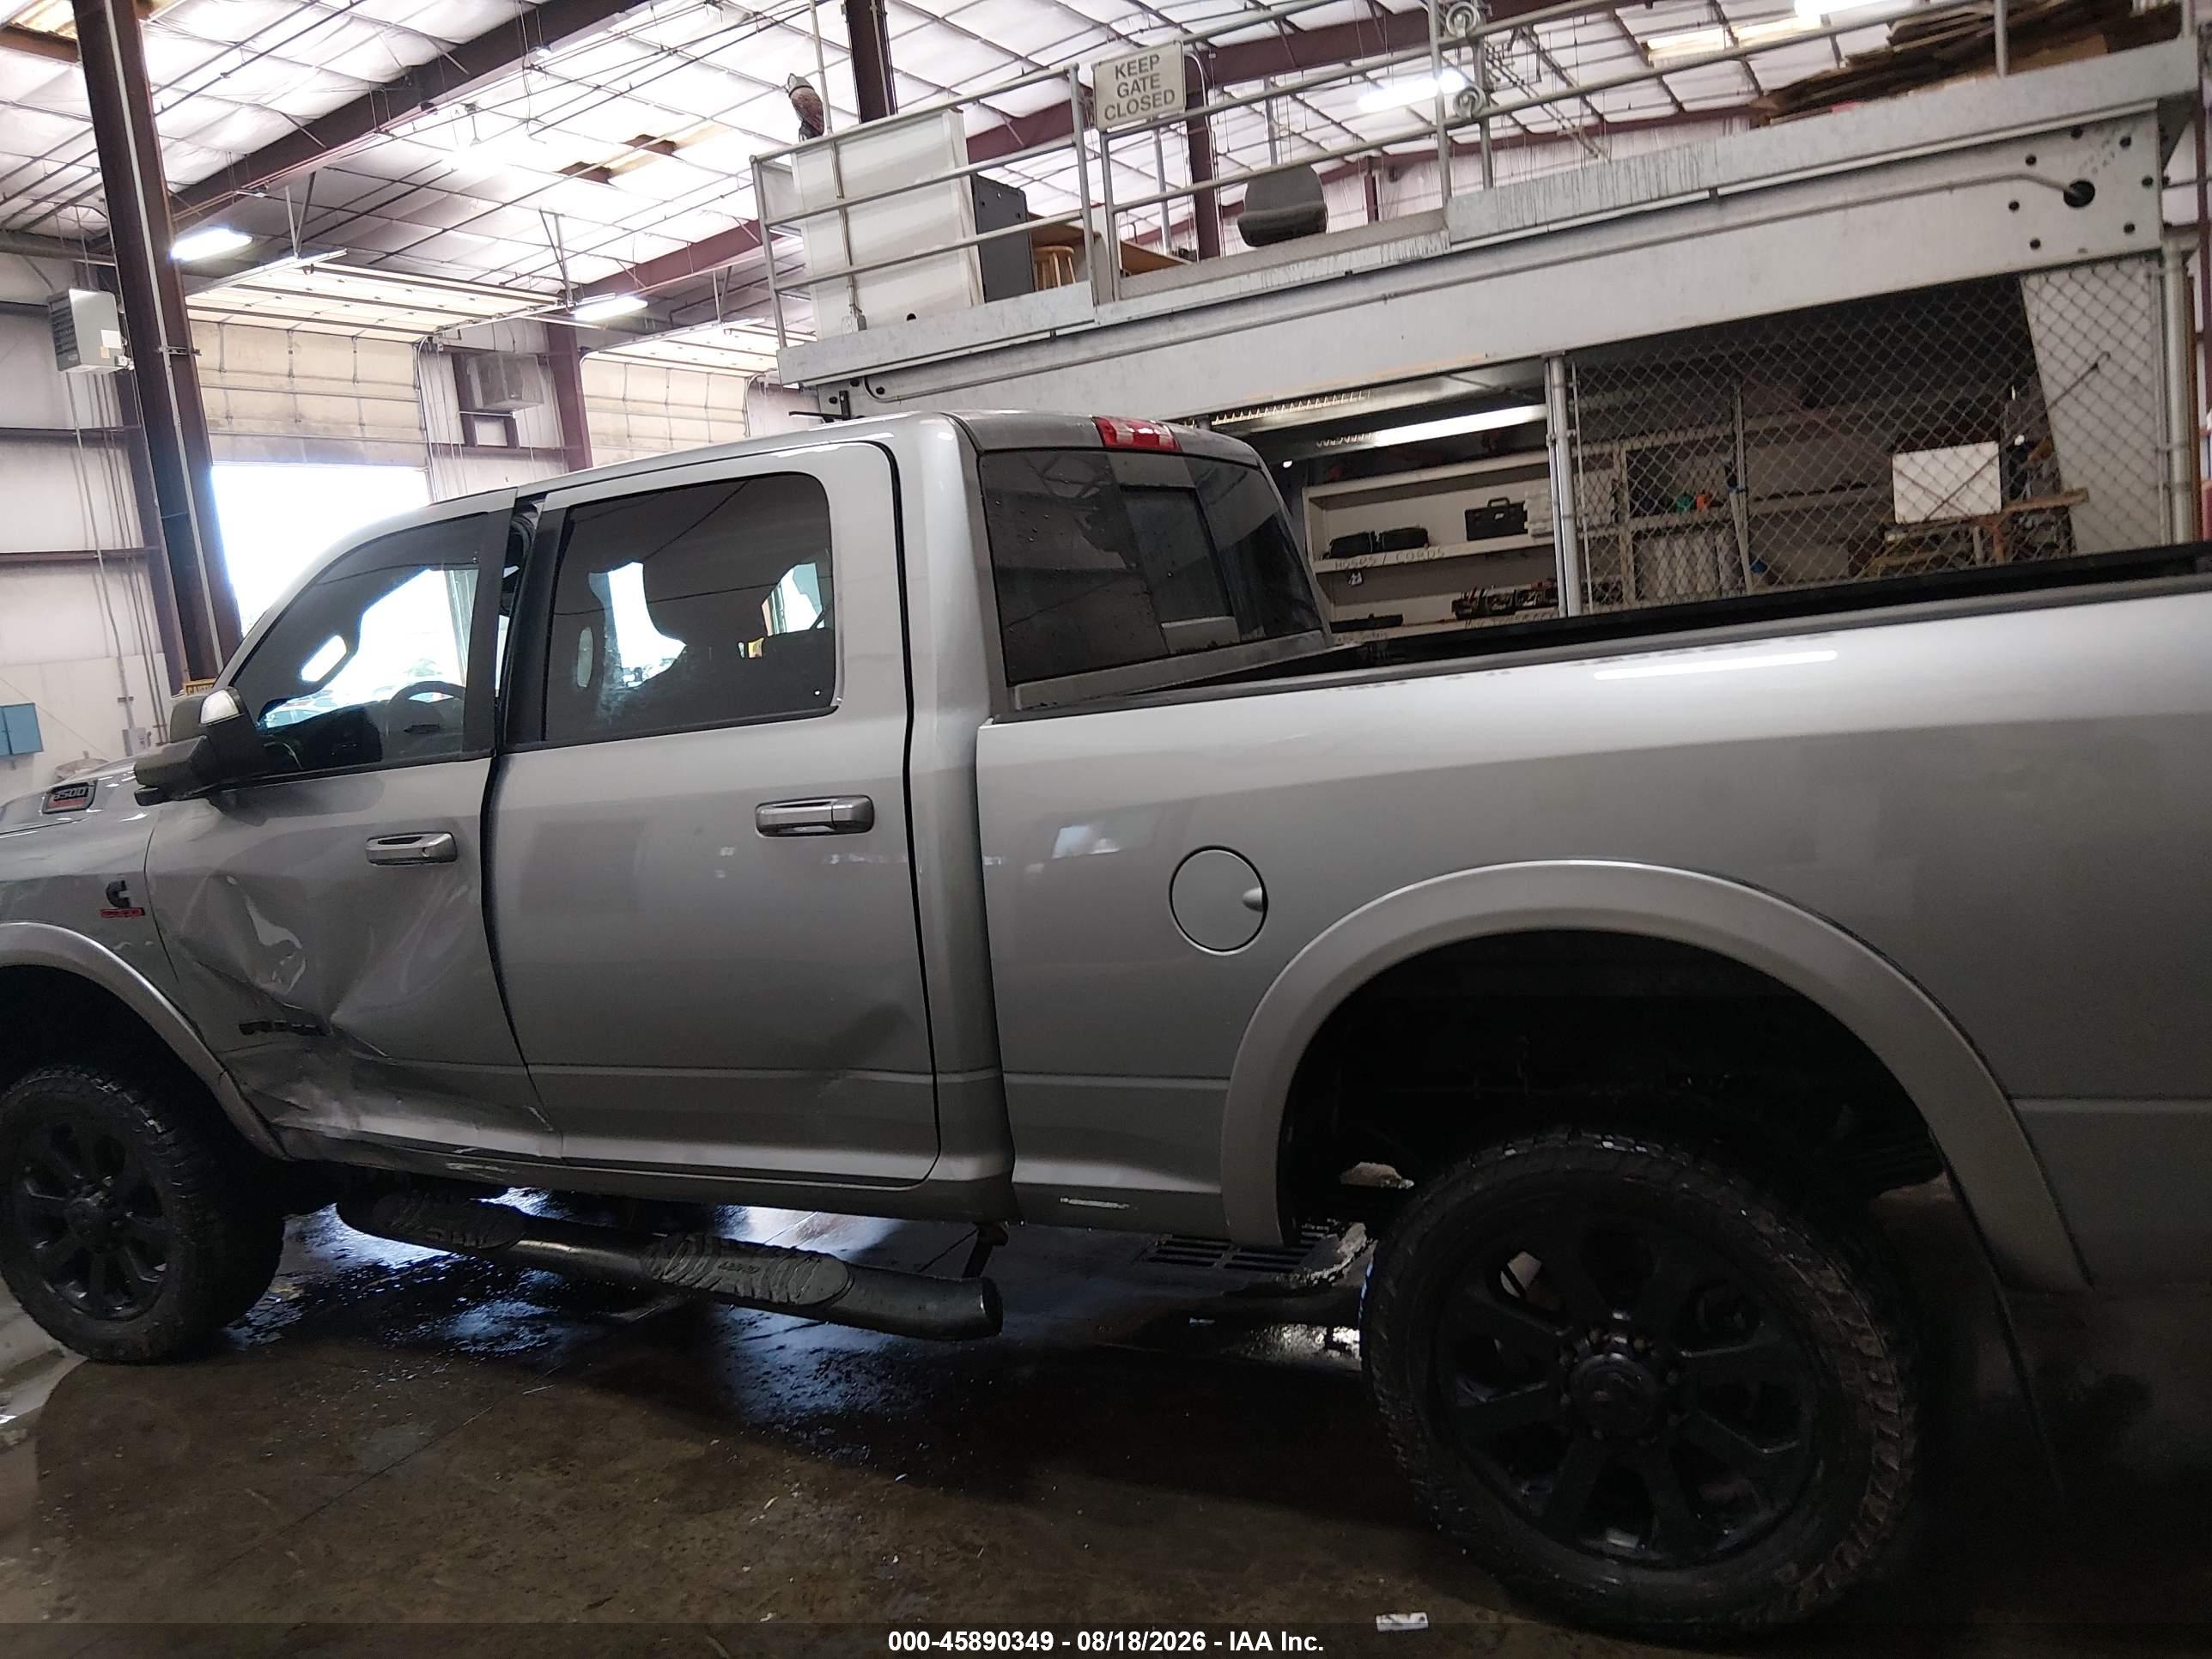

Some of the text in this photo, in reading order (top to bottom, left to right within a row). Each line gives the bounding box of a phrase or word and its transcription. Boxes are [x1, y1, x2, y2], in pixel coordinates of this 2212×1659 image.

[1115, 53, 1160, 80] KEEP
[1117, 72, 1161, 99] GATE
[1104, 88, 1176, 121] CLOSED
